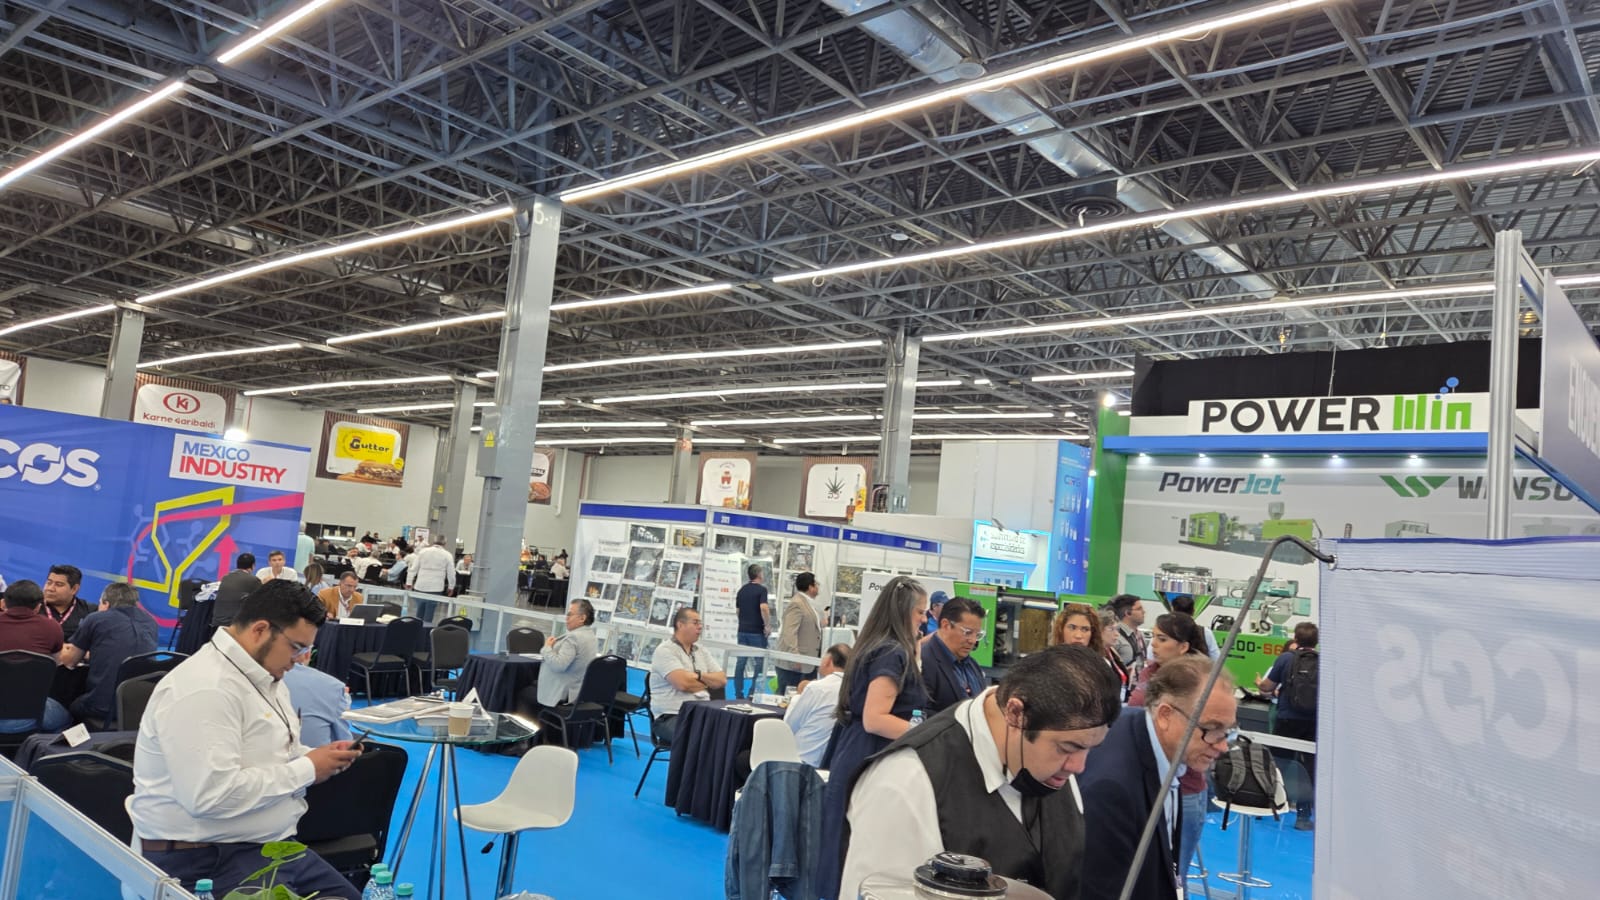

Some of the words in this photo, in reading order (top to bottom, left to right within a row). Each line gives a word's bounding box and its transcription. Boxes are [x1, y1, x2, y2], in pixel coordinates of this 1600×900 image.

[143, 412, 173, 423] Karne
[1201, 397, 1381, 432] POWER
[182, 441, 250, 462] MEXICO
[179, 455, 288, 484] INDUSTRY
[1158, 472, 1285, 495] PowerJet
